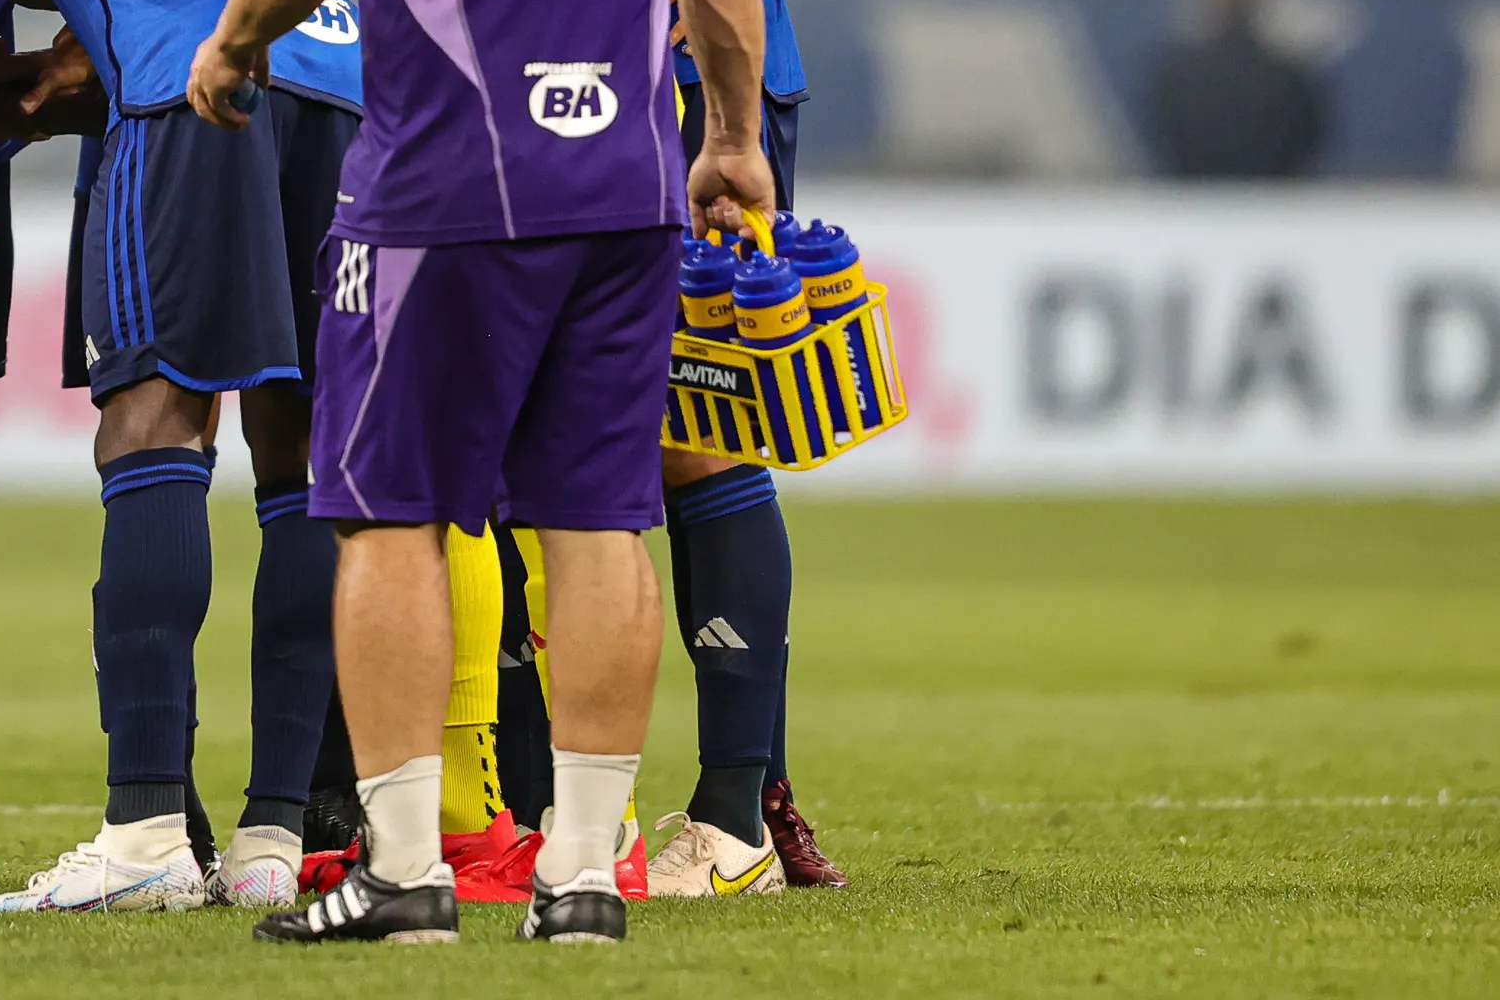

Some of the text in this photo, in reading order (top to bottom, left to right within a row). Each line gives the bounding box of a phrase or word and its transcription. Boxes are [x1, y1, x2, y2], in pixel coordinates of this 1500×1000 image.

[542, 85, 602, 119] BH
[808, 278, 853, 298] CIMED
[1020, 268, 1340, 430] DIA
[668, 361, 736, 391] LAVITAN
